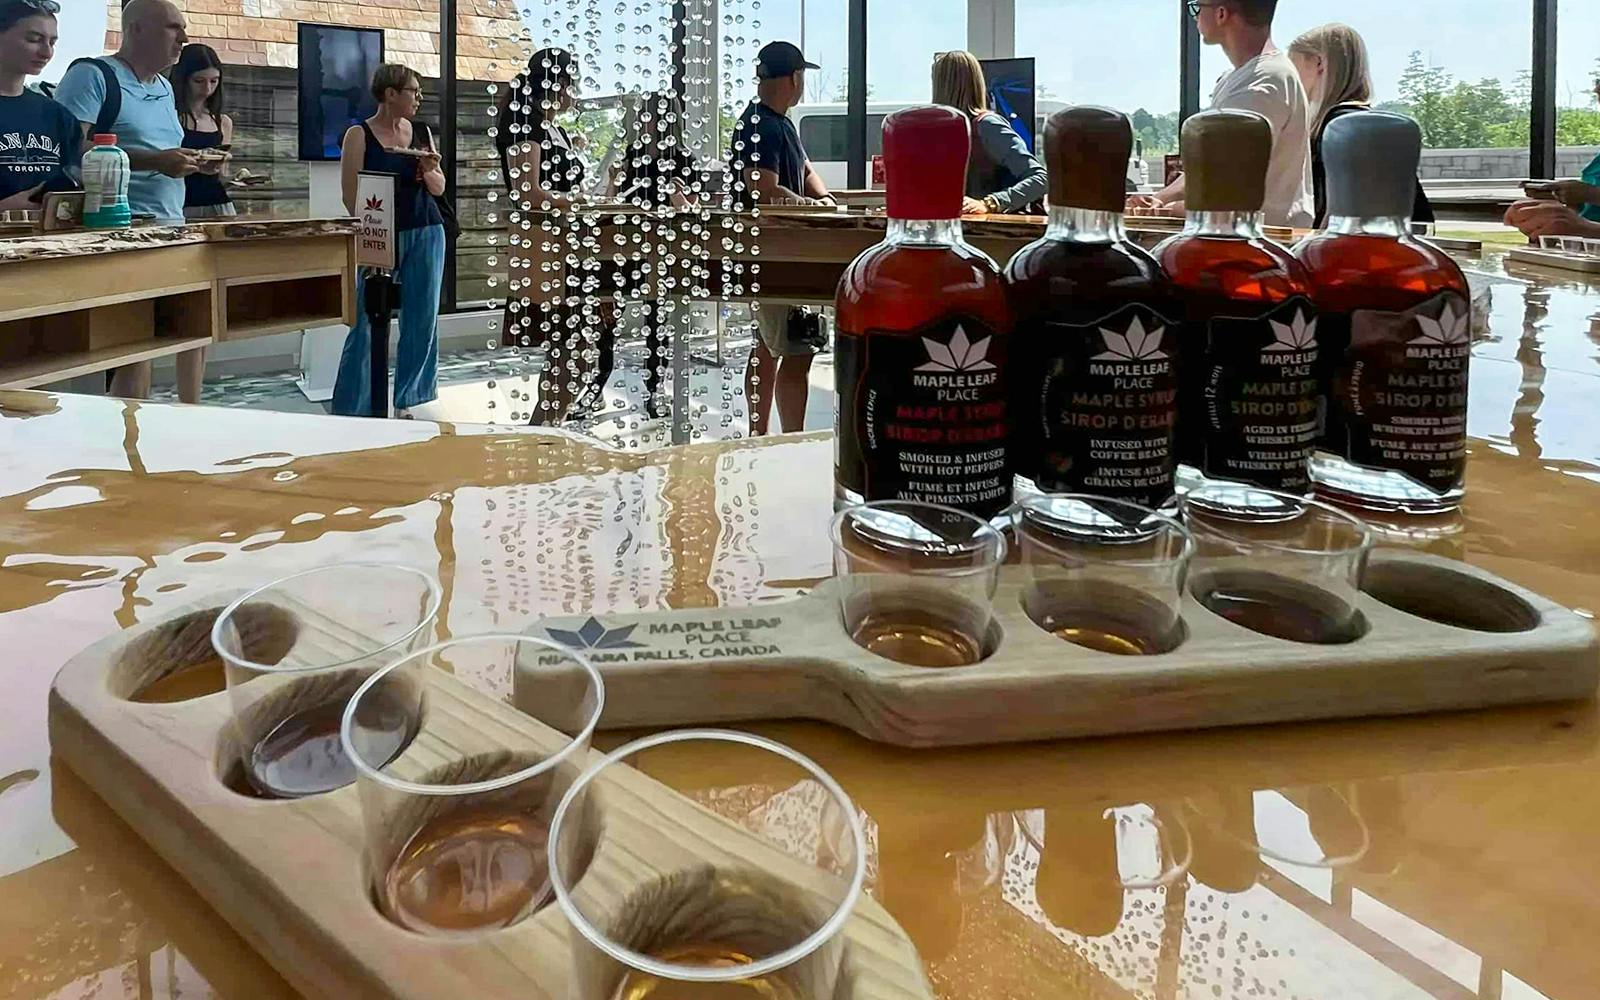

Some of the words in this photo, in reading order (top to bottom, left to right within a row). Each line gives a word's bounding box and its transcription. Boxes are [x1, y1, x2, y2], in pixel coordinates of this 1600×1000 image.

[0, 132, 61, 157] ANADA
[372, 227, 388, 238] NOT
[363, 240, 386, 250] ENTER
[1259, 353, 1302, 365] MAPLE
[1405, 347, 1452, 359] MAPLE
[1089, 363, 1141, 376] MAPLE
[1142, 361, 1170, 375] LEAF
[1281, 365, 1311, 378] PLACE
[1427, 359, 1461, 371] PLACE
[913, 375, 966, 388] MAPLE
[967, 373, 998, 387] LEAF
[1113, 377, 1154, 390] PLACE
[1387, 373, 1446, 388] MAPLE
[937, 388, 980, 401] PLACE
[1204, 386, 1217, 399] 12
[1242, 381, 1297, 396] MAPLE
[1071, 391, 1136, 409] MAPLE
[1375, 392, 1433, 408] SIROP
[1231, 401, 1285, 416] SIROP
[1059, 411, 1119, 429] SIROP
[1242, 425, 1275, 434] AGED
[1089, 438, 1142, 450] INFUSED
[898, 451, 952, 464] SMOKED
[954, 455, 963, 464] &
[1089, 450, 1136, 461] COFFEE
[1137, 447, 1169, 460] BEANS
[899, 462, 934, 475] WITH
[936, 465, 962, 476] HOT
[964, 458, 1005, 475] PEPPERS
[946, 484, 962, 493] ET
[1083, 476, 1132, 488] GRAINS
[897, 490, 922, 503] AUX
[924, 492, 978, 504] PIMENTS
[649, 621, 725, 634] MAPLE
[728, 617, 782, 630] LEAF
[685, 632, 751, 645] PLACE
[634, 649, 694, 661] FALLS,
[699, 645, 782, 658] CANADA
